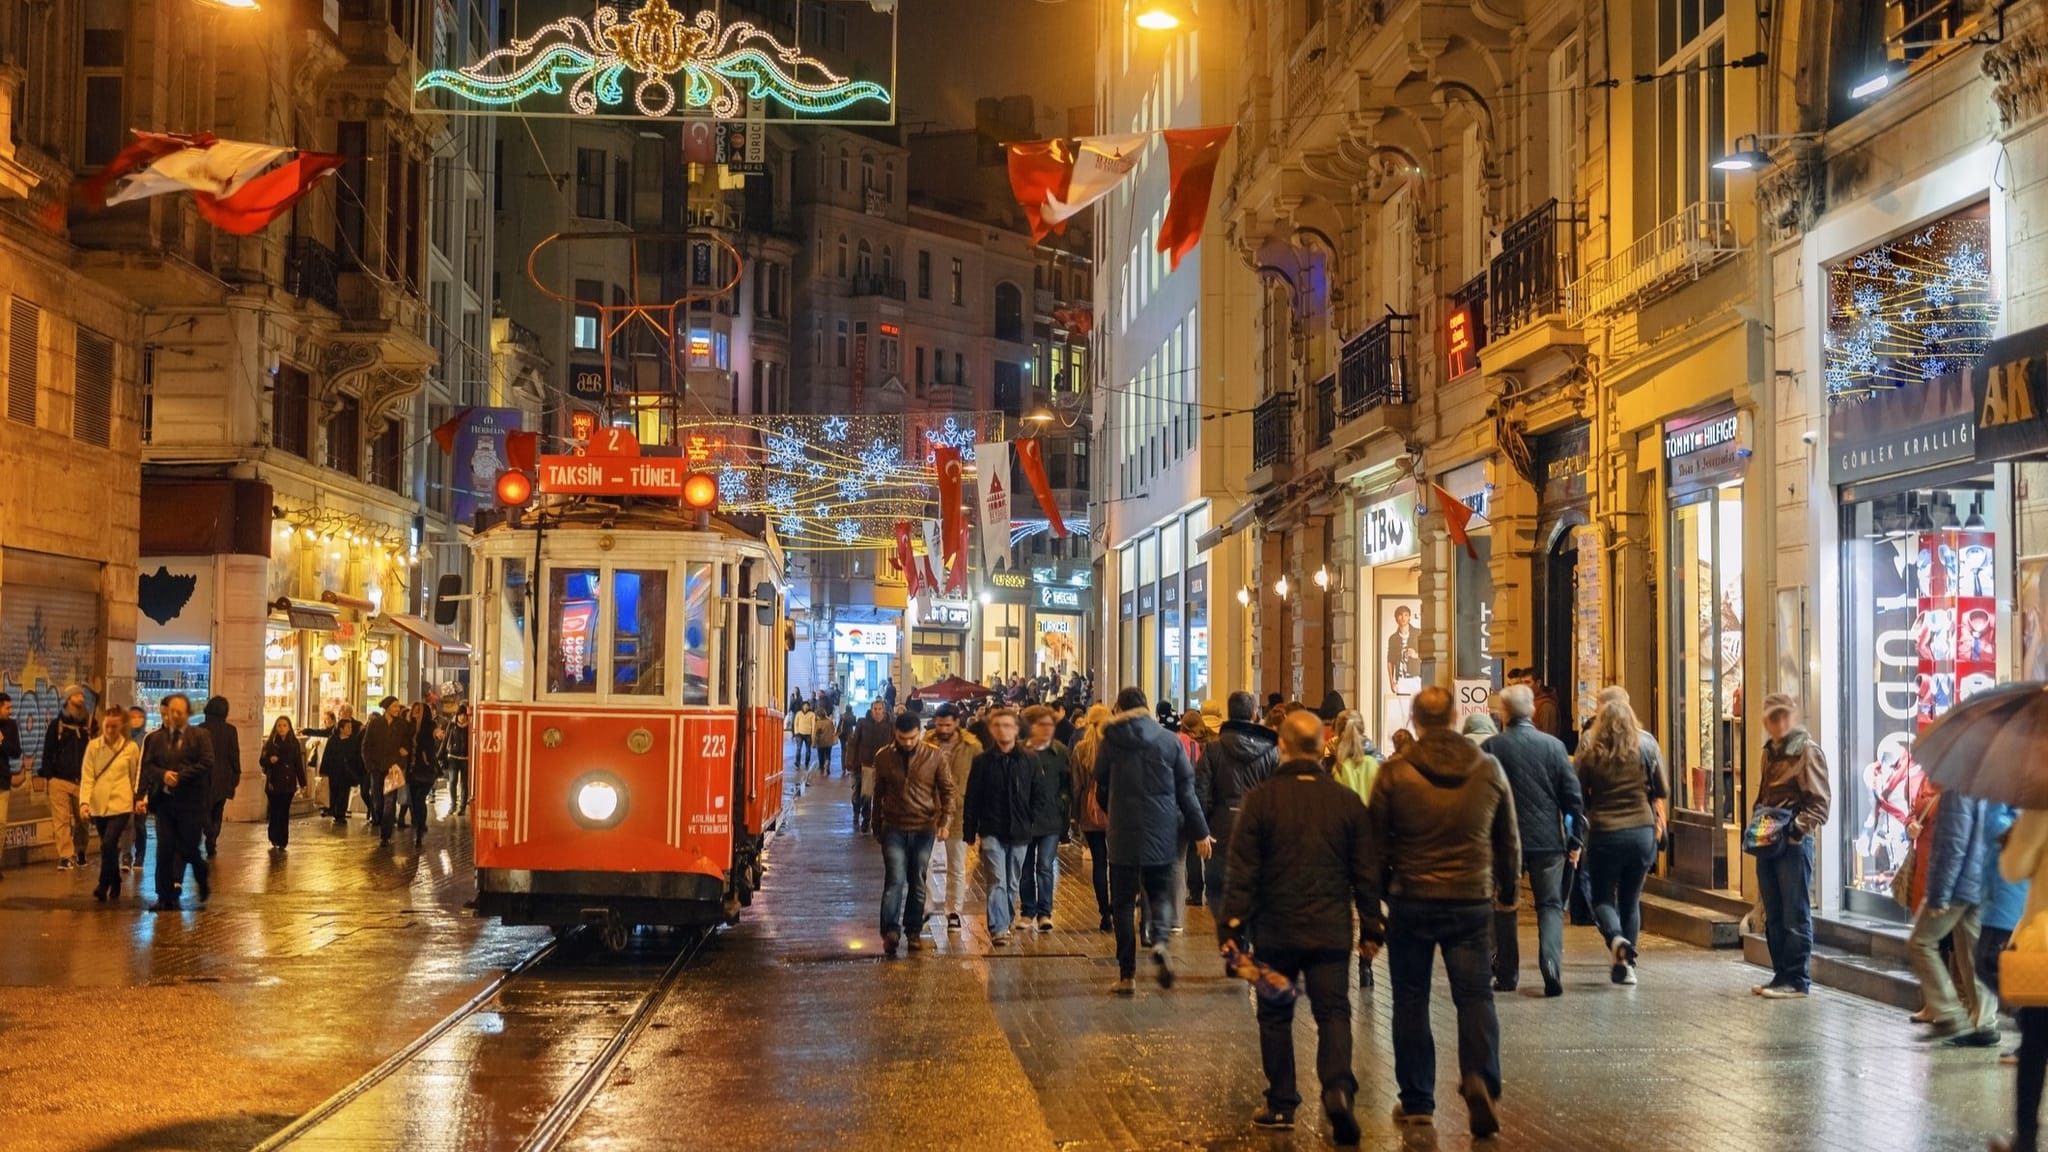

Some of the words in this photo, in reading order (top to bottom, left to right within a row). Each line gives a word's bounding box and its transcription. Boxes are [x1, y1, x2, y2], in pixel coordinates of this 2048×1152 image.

[608, 428, 619, 451] 2
[1665, 430, 1696, 459] TOMMY
[1703, 415, 1738, 446] HILFIGER
[1842, 444, 1894, 471] GÖMLEK
[548, 463, 602, 485] TAKSİM
[630, 464, 681, 487] TÜNEL
[1364, 507, 1387, 555] LTB
[480, 731, 501, 753] 223
[702, 735, 726, 758] 223
